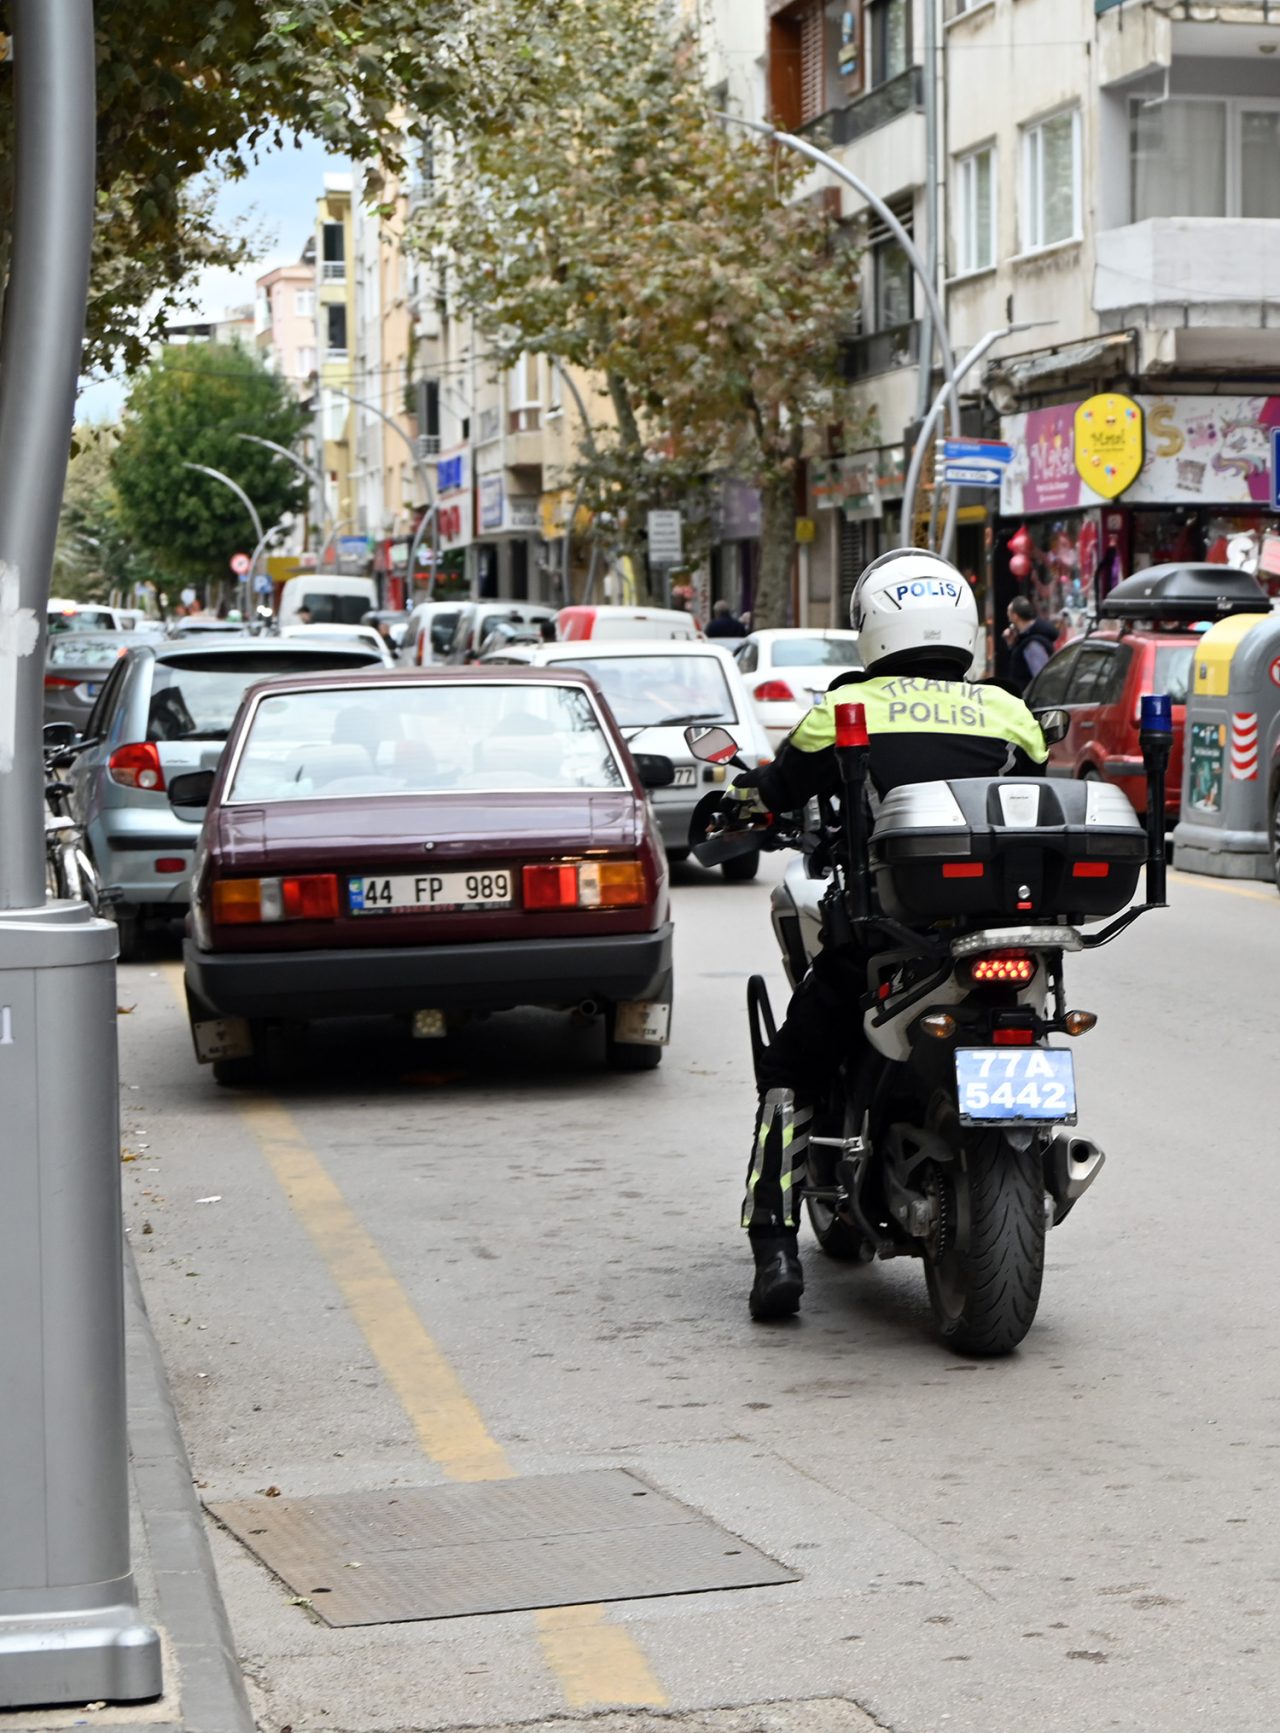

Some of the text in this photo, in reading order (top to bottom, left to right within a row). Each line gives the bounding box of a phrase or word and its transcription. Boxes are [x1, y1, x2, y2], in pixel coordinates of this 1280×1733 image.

[365, 880, 393, 905] 44
[414, 878, 443, 903] FP
[466, 874, 508, 900] 989
[972, 1052, 1055, 1078] 77A
[966, 1082, 1067, 1109] 5442
